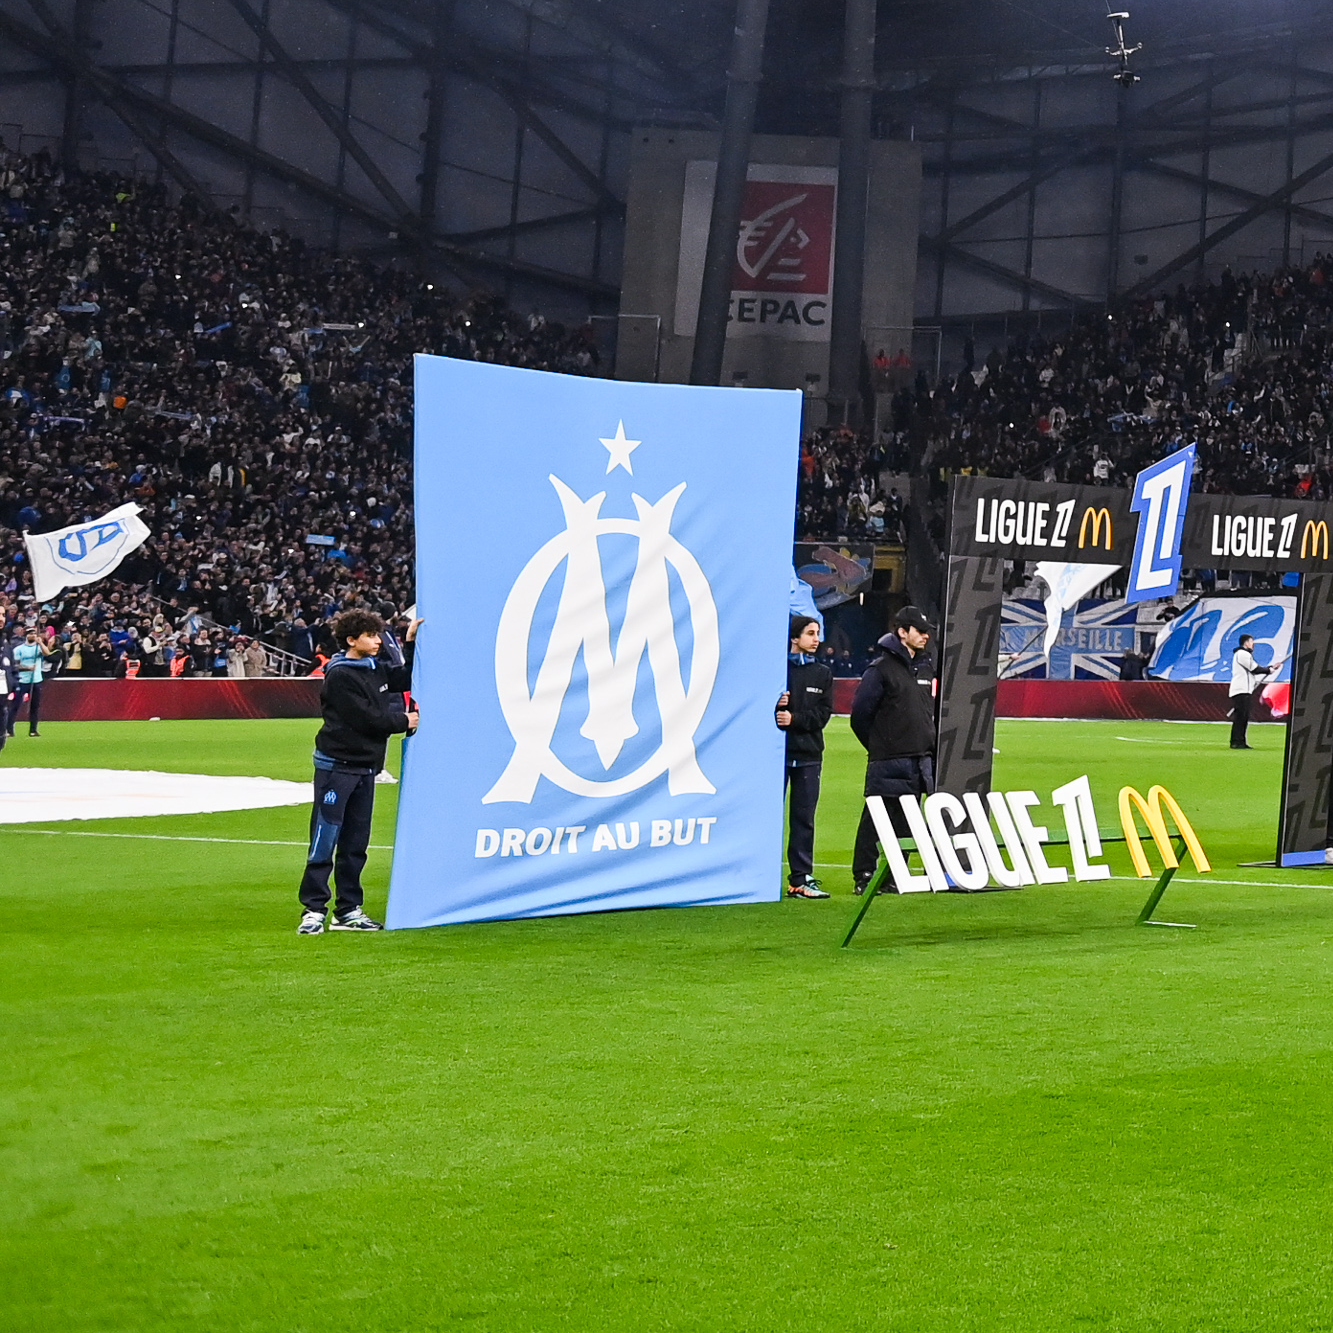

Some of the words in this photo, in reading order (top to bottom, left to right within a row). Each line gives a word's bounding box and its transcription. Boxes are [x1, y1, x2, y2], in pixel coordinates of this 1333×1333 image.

[1024, 628, 1124, 651] MRSEILLE
[474, 824, 587, 859] DROIT
[593, 820, 640, 852] AU
[651, 816, 717, 846] BUT
